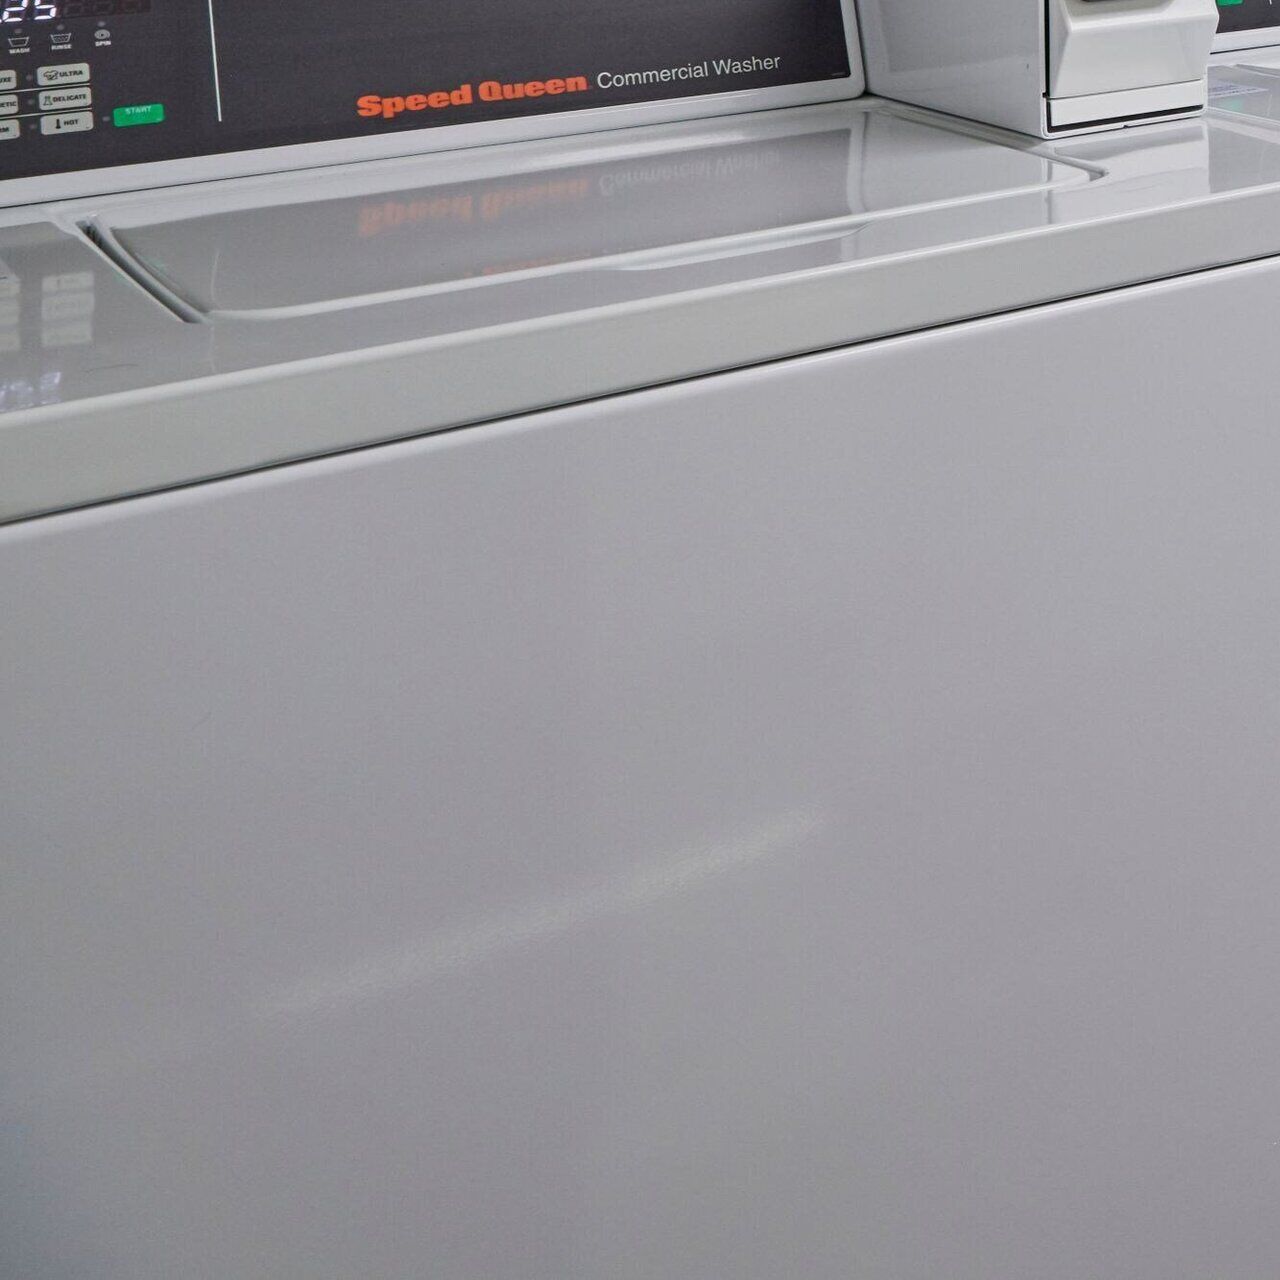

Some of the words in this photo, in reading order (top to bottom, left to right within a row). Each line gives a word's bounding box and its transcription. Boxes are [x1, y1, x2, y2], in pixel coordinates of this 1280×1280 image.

[51, 43, 72, 51] RINSE
[59, 69, 84, 78] ULTRA
[356, 83, 473, 118] Speed
[478, 75, 589, 102] Queen
[597, 61, 709, 89] Commercial
[712, 54, 781, 76] Washer
[52, 93, 87, 103] DELICATE
[124, 105, 152, 115] START
